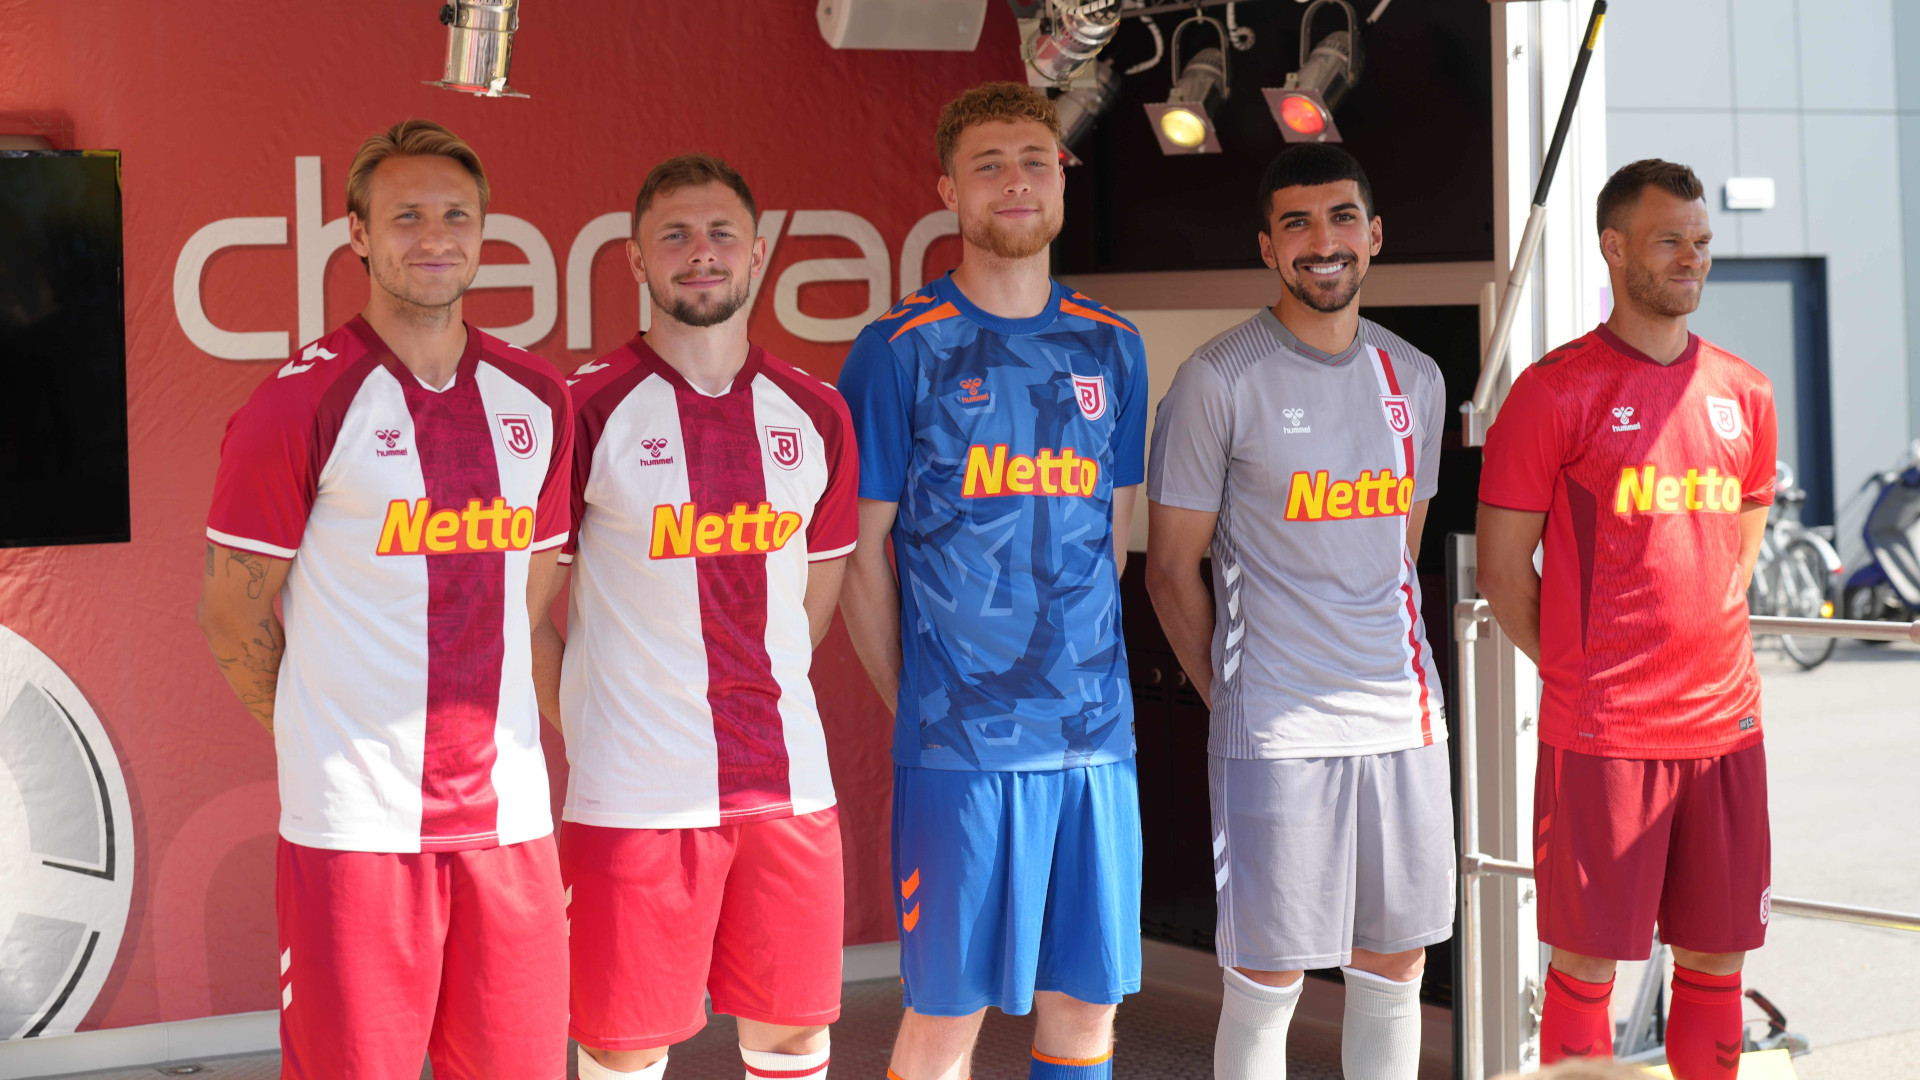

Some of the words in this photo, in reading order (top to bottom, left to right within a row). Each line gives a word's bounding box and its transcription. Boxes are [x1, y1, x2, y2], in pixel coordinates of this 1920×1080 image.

[961, 393, 989, 404] hummel
[1283, 425, 1311, 434] hummel
[1612, 422, 1640, 432] hummel
[376, 448, 407, 457] hummel
[640, 456, 673, 466] hummel
[963, 446, 1096, 496] Netto
[1286, 471, 1413, 519] Netto
[1616, 466, 1741, 513] Netto
[378, 500, 533, 553] Netto
[651, 504, 800, 557] Netto
